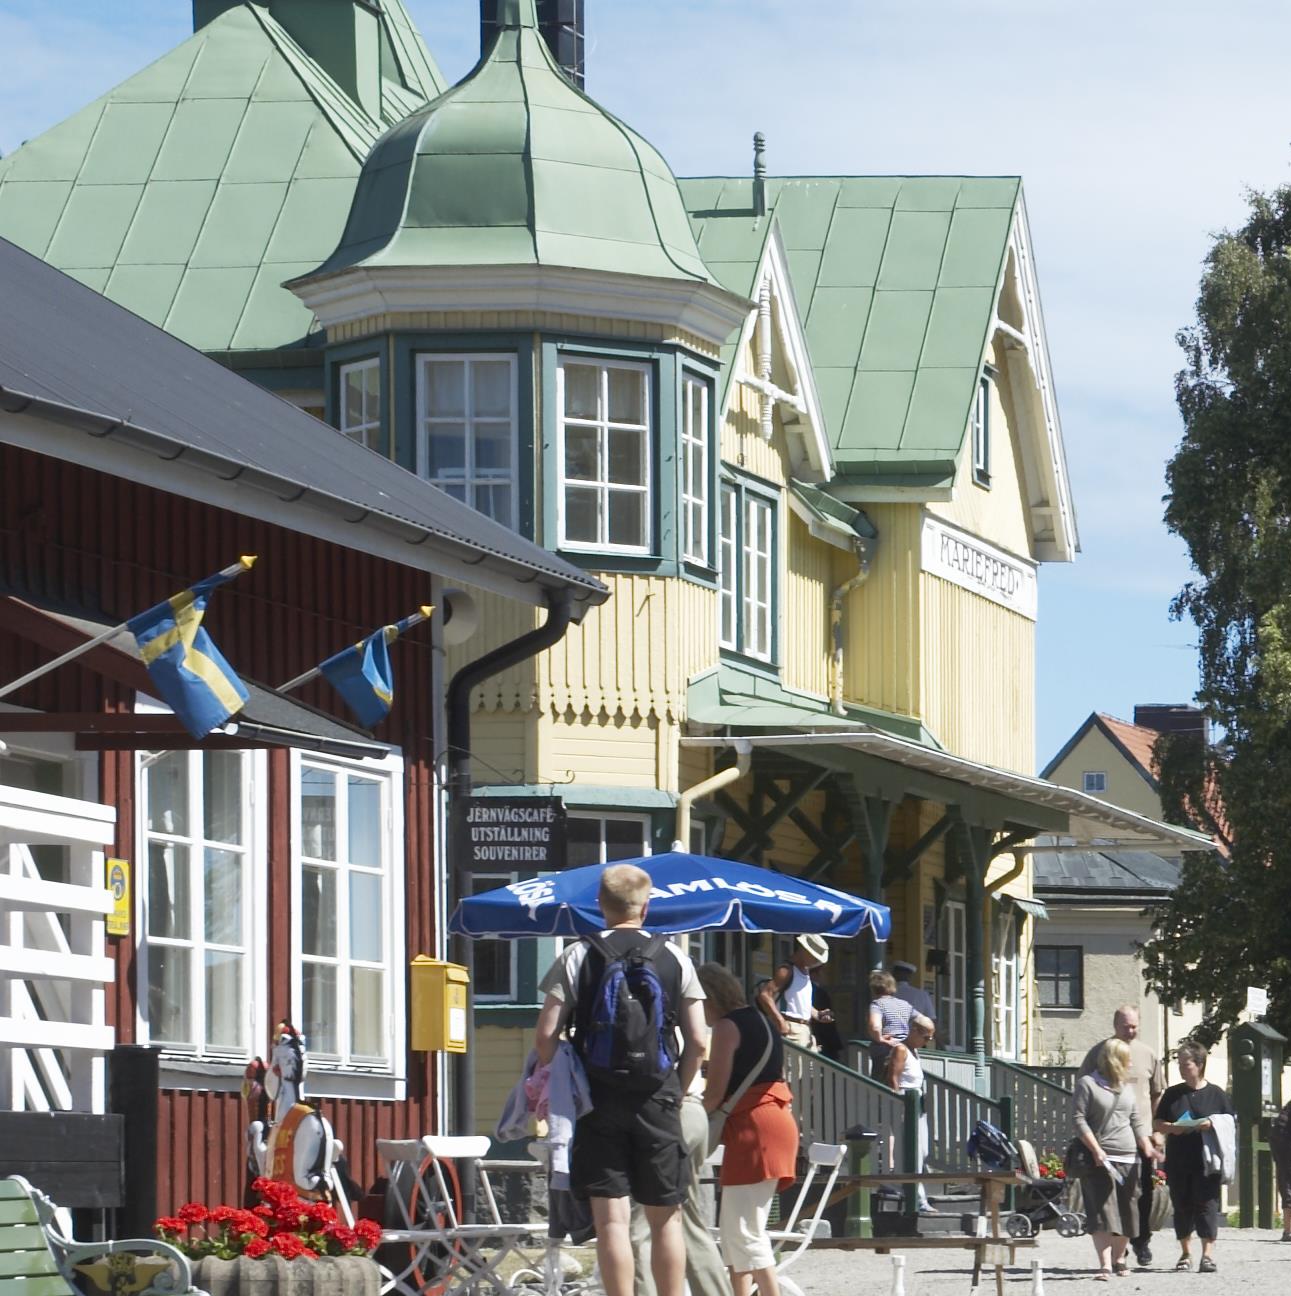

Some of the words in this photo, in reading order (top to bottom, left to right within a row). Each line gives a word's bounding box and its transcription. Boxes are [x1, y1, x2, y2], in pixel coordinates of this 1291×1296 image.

[471, 825, 550, 842] UTSTÄLLNING
[473, 846, 547, 861] SOUVENIRER
[648, 876, 843, 924] AMLÖSA
